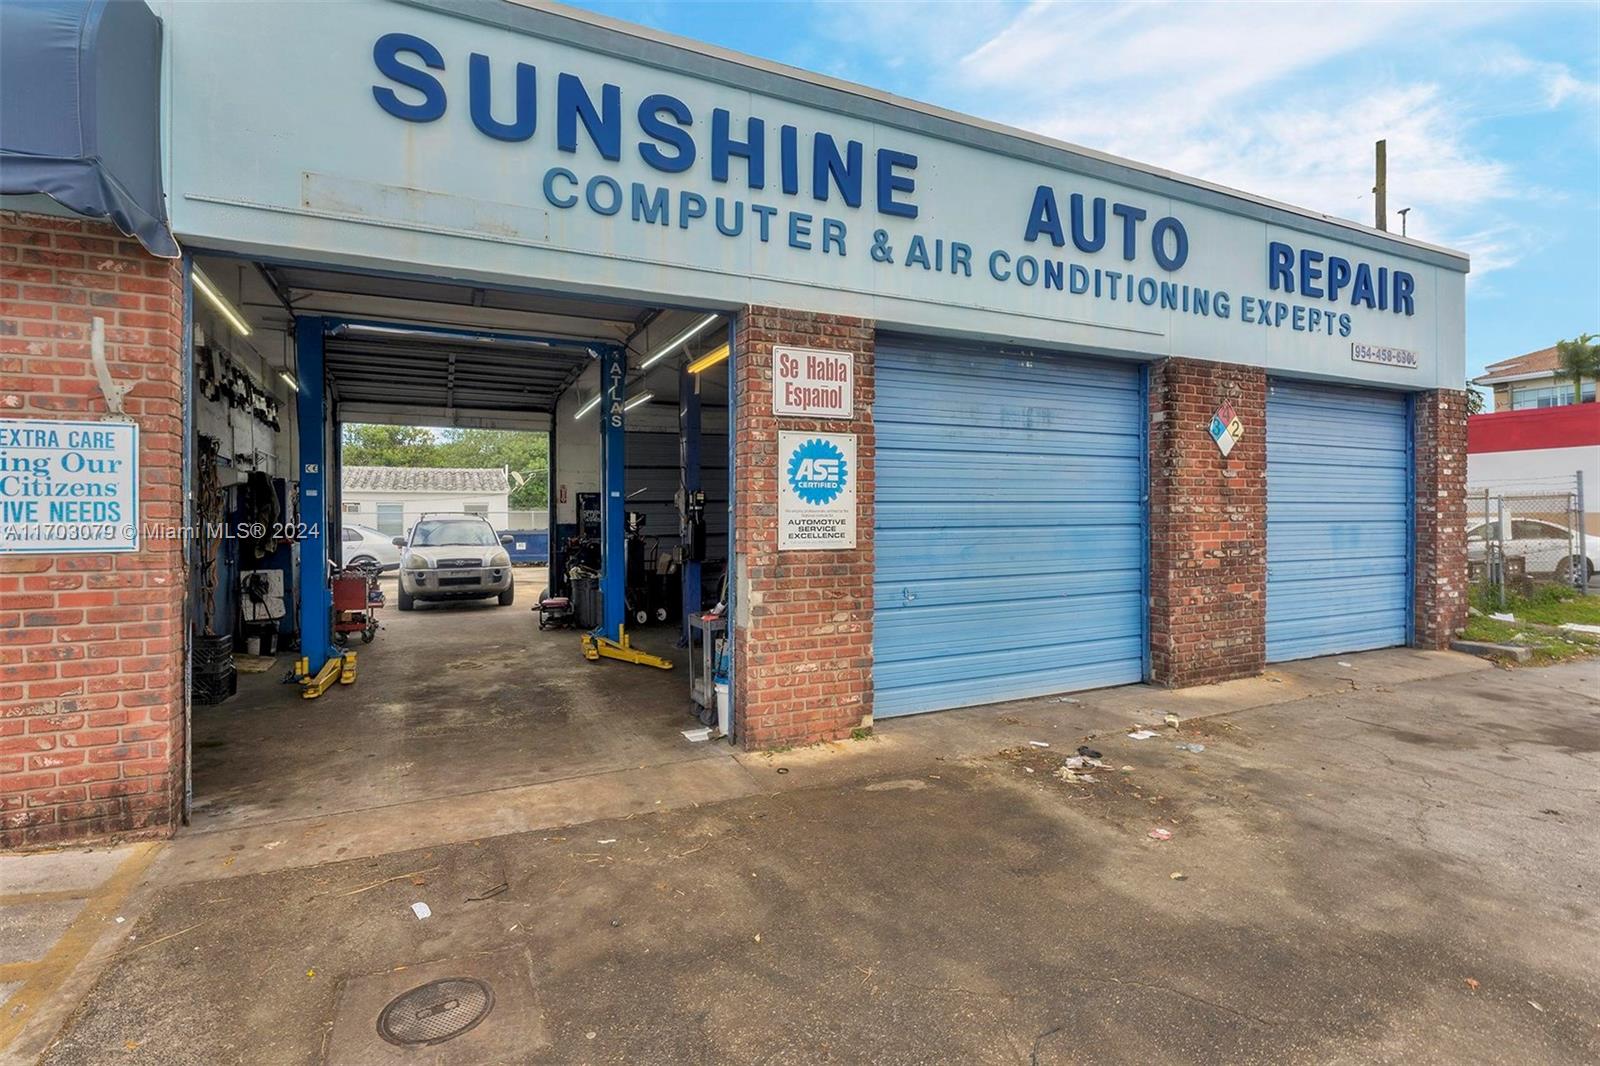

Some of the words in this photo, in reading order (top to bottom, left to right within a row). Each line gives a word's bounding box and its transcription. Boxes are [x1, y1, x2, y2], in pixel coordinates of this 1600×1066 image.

[372, 33, 918, 219] SUNSHINE
[1024, 185, 1189, 271] AUTO
[1269, 241, 1415, 316] REPAIR
[542, 167, 848, 256] COMPUTER
[870, 229, 894, 264] &
[904, 235, 973, 278] AIR
[989, 250, 1231, 318] CONDITIONING
[1241, 296, 1352, 337] EXPERTS
[779, 353, 799, 379] Se
[807, 355, 847, 383] Habla
[610, 362, 622, 427] ATLAS
[785, 382, 842, 410] Español
[0, 429, 59, 447] EXTRA
[69, 431, 115, 449] CARE
[1231, 420, 1240, 437] 2
[61, 452, 122, 474] Our
[795, 458, 838, 481] ASE
[0, 476, 117, 497] Citizens
[0, 501, 39, 523] IVE
[49, 501, 121, 523] NEEDS
[788, 518, 846, 526] AUTOMOTIVE
